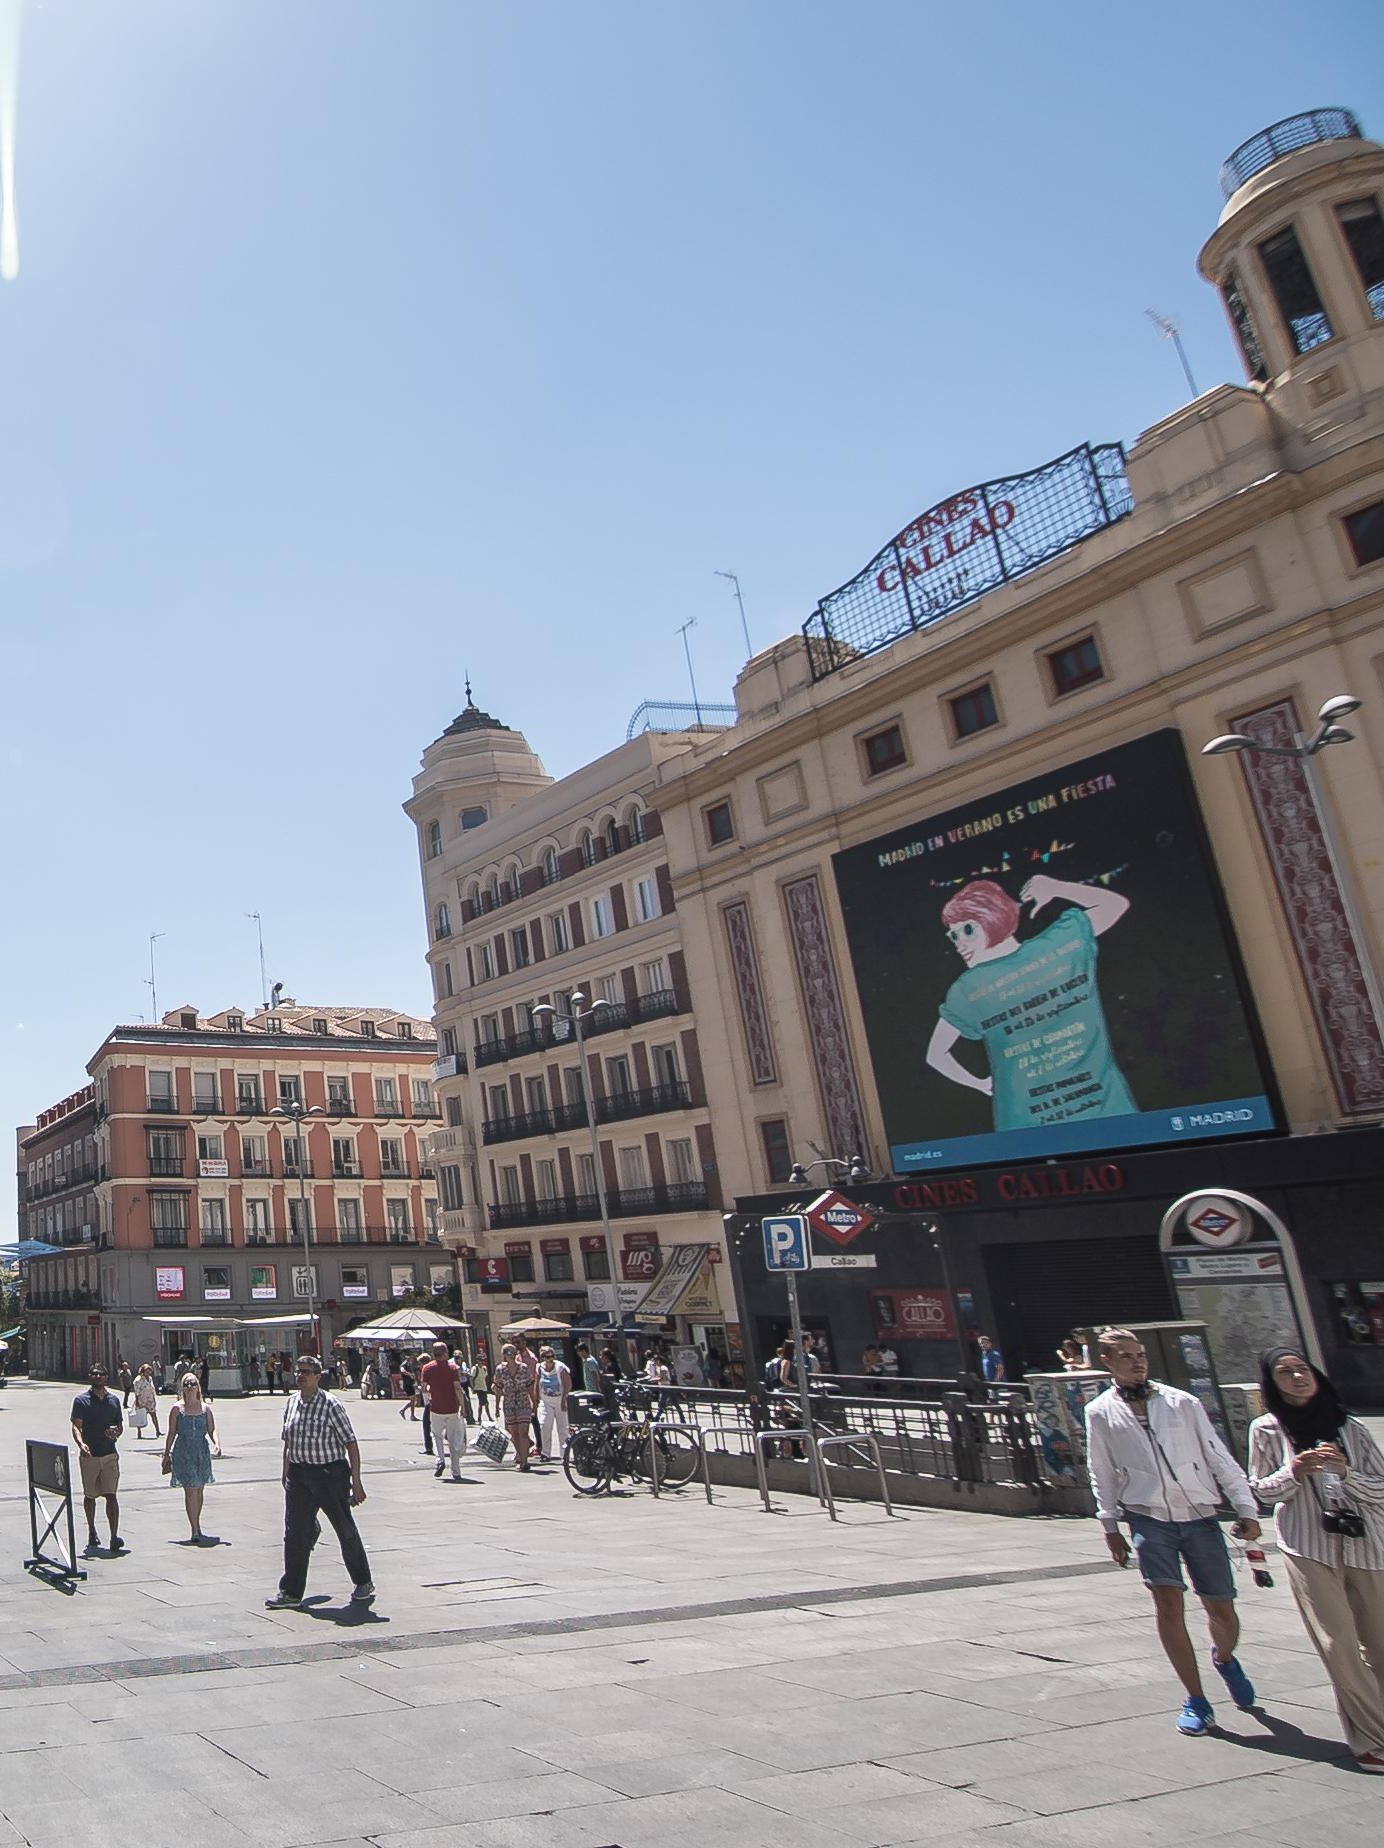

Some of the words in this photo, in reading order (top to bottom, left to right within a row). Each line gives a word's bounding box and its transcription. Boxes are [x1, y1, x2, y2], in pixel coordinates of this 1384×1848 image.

[898, 489, 979, 550] CINES
[877, 500, 1016, 593] CALLAO
[927, 835, 944, 851] EN
[947, 812, 1003, 845] VERANO
[1007, 806, 1025, 825] ES
[1189, 1108, 1254, 1127] MADRID
[895, 1178, 980, 1209] CINES
[998, 1164, 1124, 1201] CALLAO
[826, 1210, 858, 1223] Metro
[769, 1223, 795, 1265] P
[830, 1256, 858, 1266] Callao
